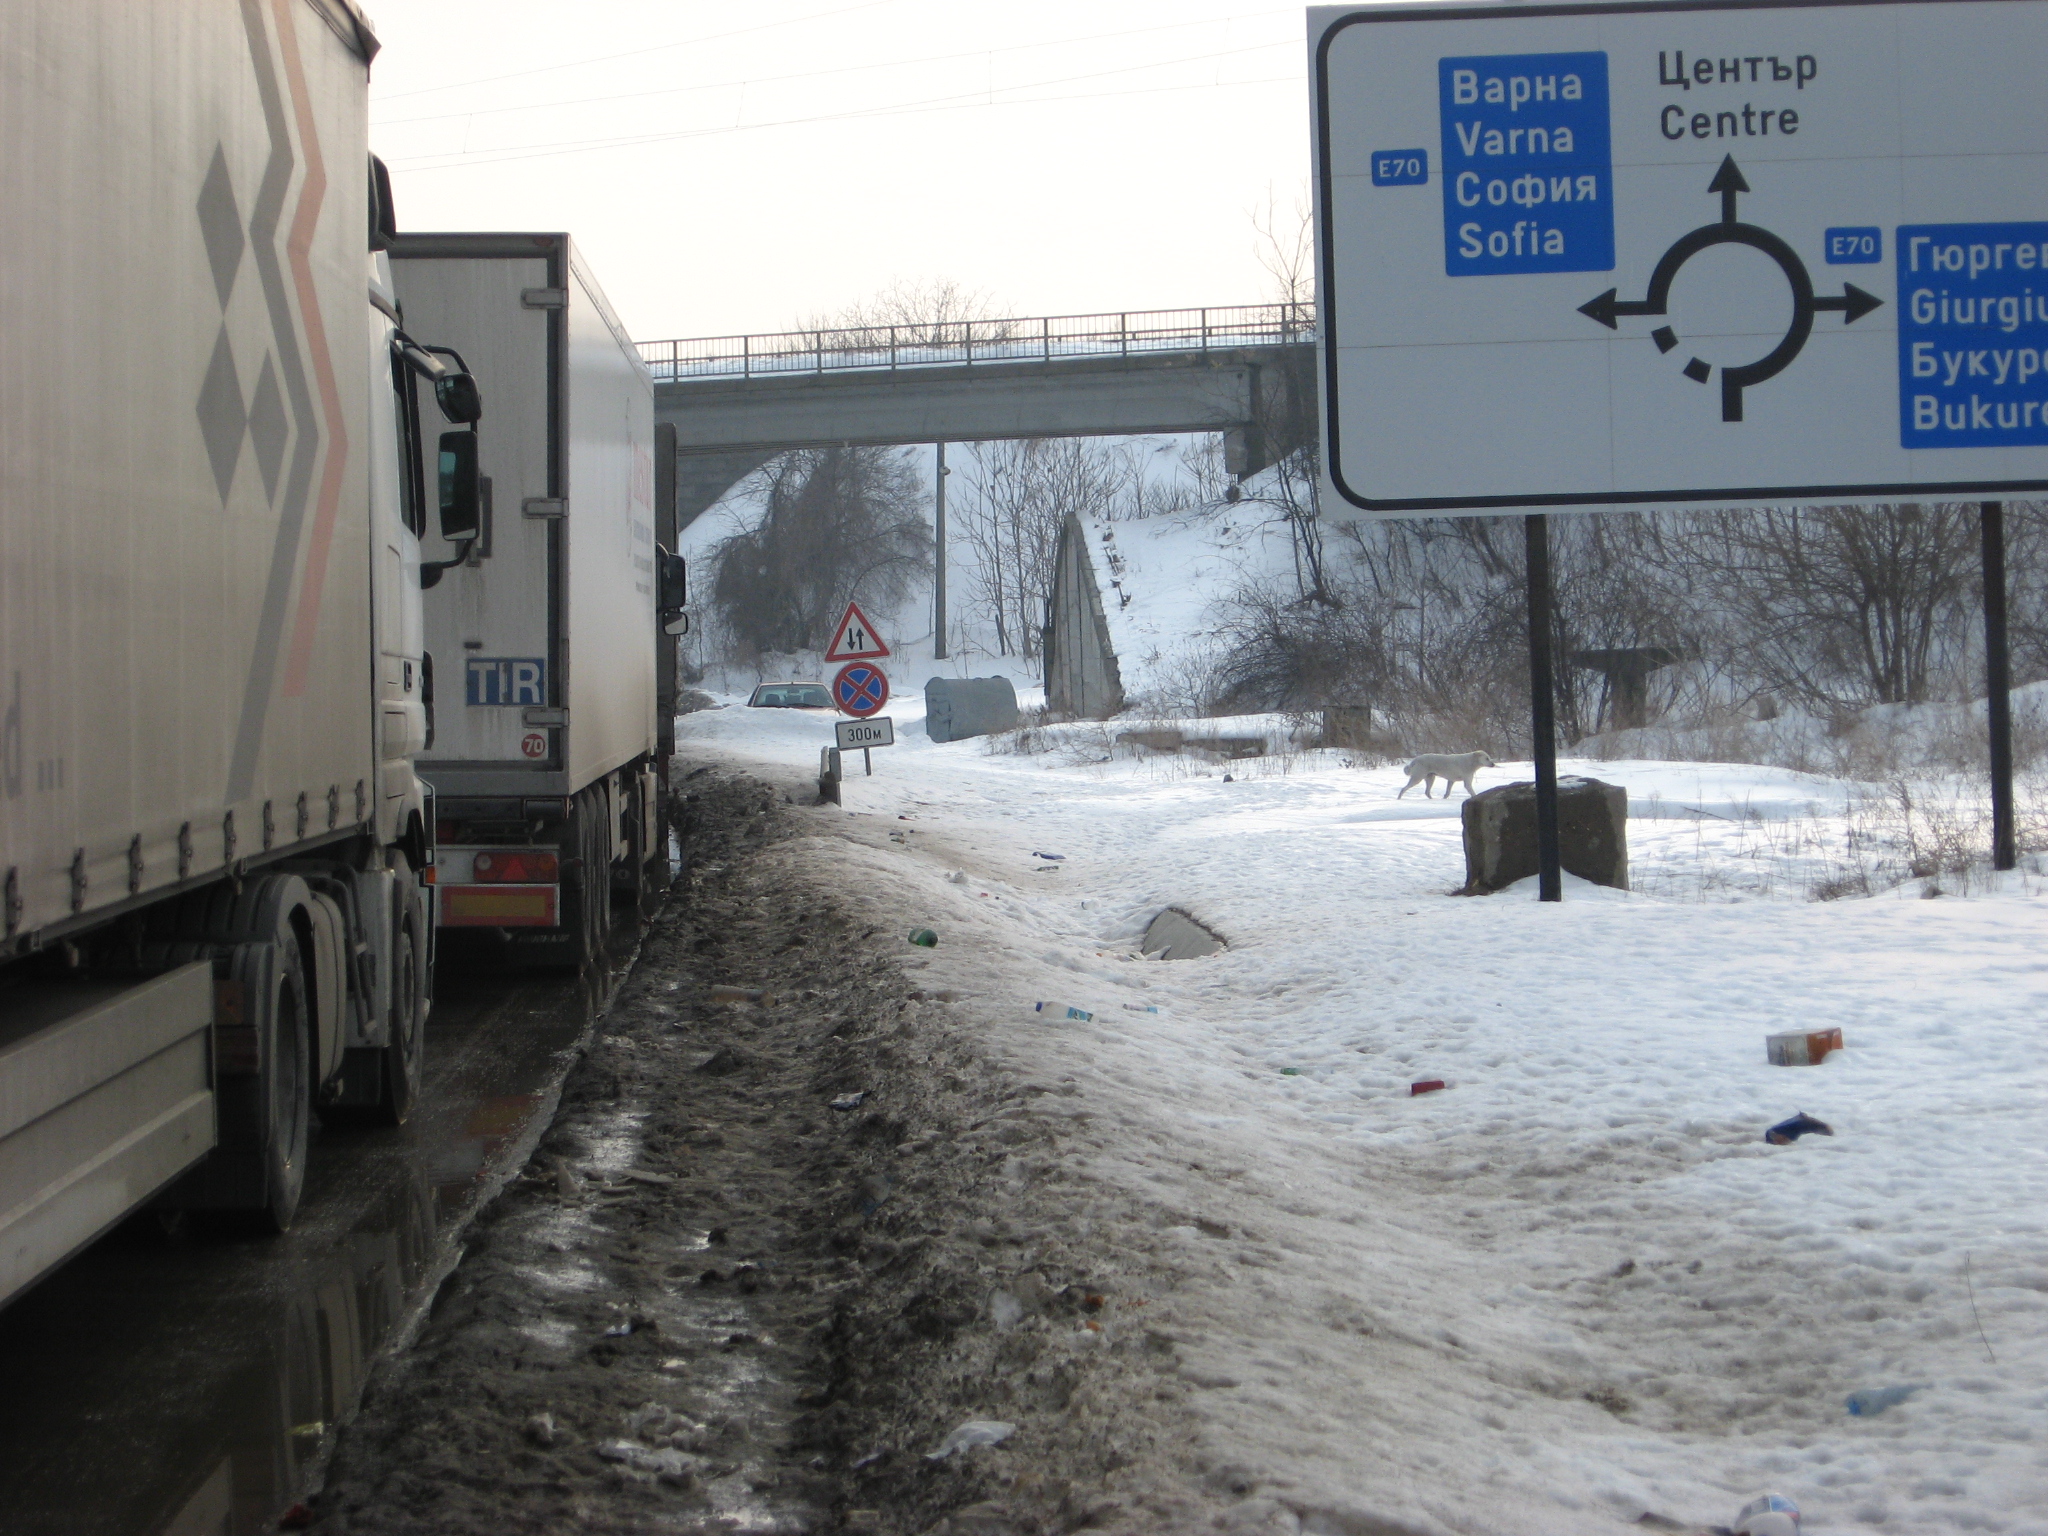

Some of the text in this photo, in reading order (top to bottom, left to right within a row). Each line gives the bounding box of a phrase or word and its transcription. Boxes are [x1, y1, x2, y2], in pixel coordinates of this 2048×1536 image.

[1659, 50, 1818, 91] Център
[1453, 69, 1582, 111] Варна
[1455, 121, 1574, 157] Varna
[1660, 102, 1799, 140] Centre
[1379, 158, 1420, 178] E70
[1456, 171, 1597, 208] София
[1459, 220, 1565, 258] Sofia
[1832, 236, 1874, 256] E70
[1912, 341, 2048, 386] Букур
[468, 661, 541, 704] TIR
[524, 738, 545, 753] 70
